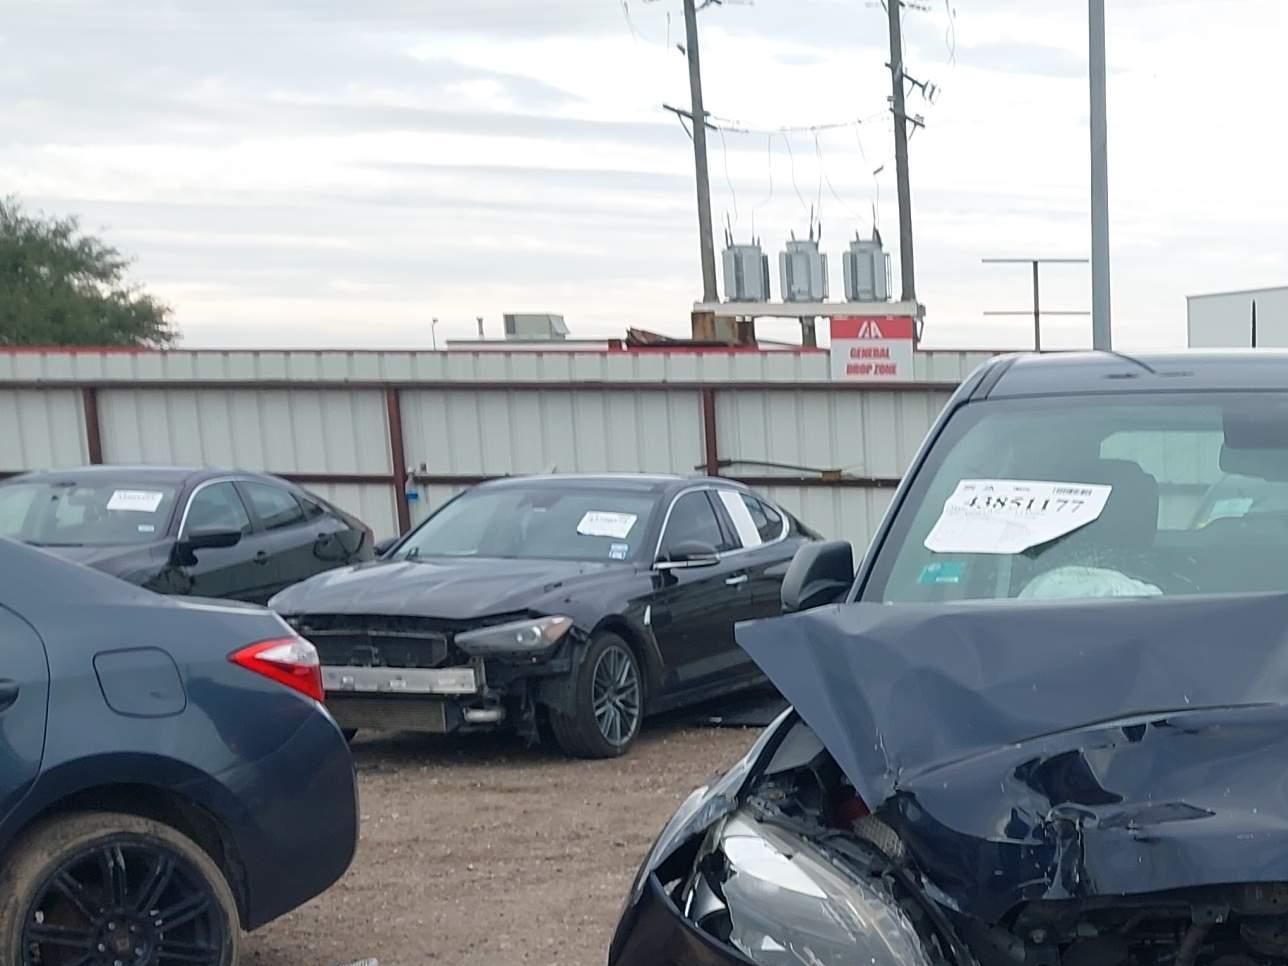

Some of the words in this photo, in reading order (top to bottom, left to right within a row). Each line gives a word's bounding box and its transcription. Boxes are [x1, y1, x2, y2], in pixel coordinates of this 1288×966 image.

[850, 347, 890, 358] GENERAL
[846, 363, 871, 375] DROP
[873, 363, 897, 375] ZONE
